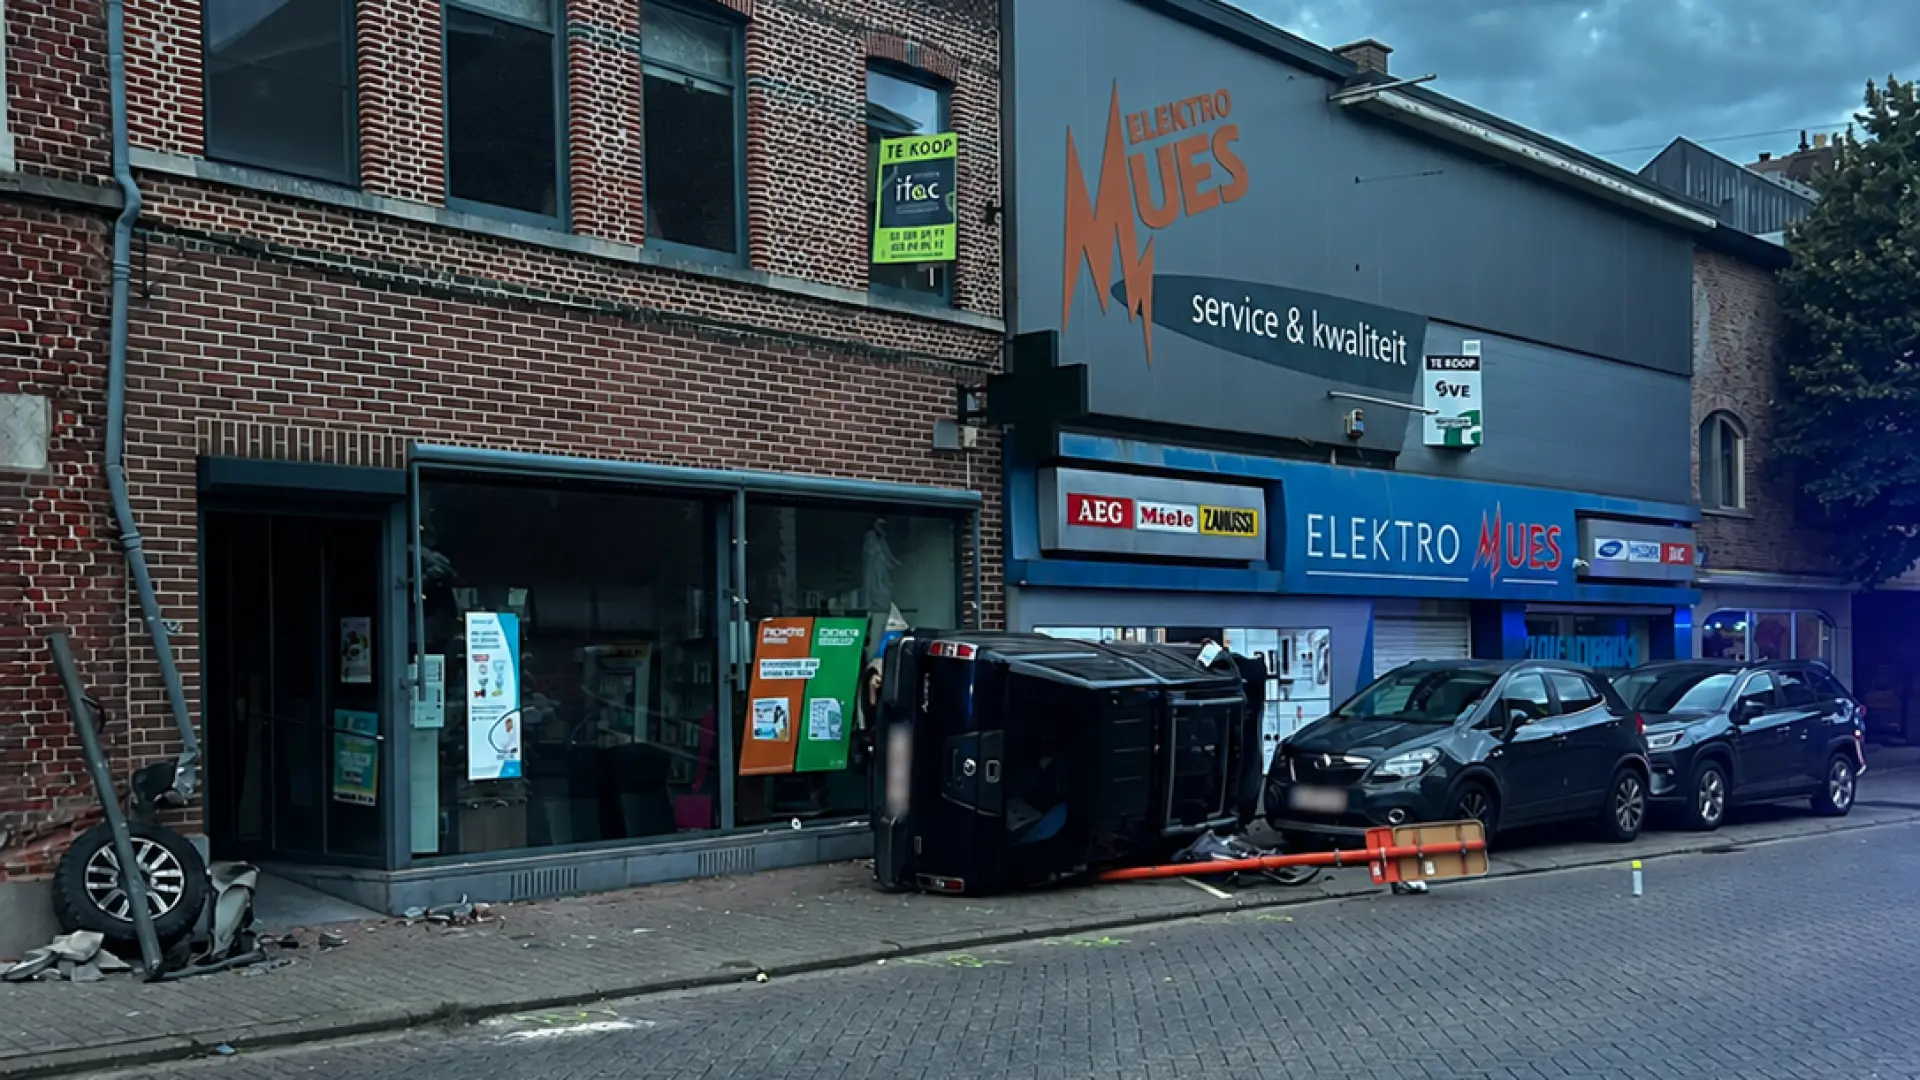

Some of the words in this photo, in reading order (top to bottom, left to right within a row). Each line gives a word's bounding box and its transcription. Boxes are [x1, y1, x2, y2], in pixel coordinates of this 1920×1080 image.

[1126, 87, 1232, 146] ELEKTRO
[887, 144, 903, 159] TE
[910, 138, 952, 156] KOOP
[1062, 77, 1249, 371] MUES
[1192, 294, 1279, 339] service
[1286, 307, 1305, 344] &
[1312, 309, 1408, 366] kwaliteit
[1078, 498, 1124, 524] AEG
[1140, 506, 1194, 528] Miele
[1307, 513, 1461, 565] ELEKTRO
[1472, 500, 1562, 590] MUES
